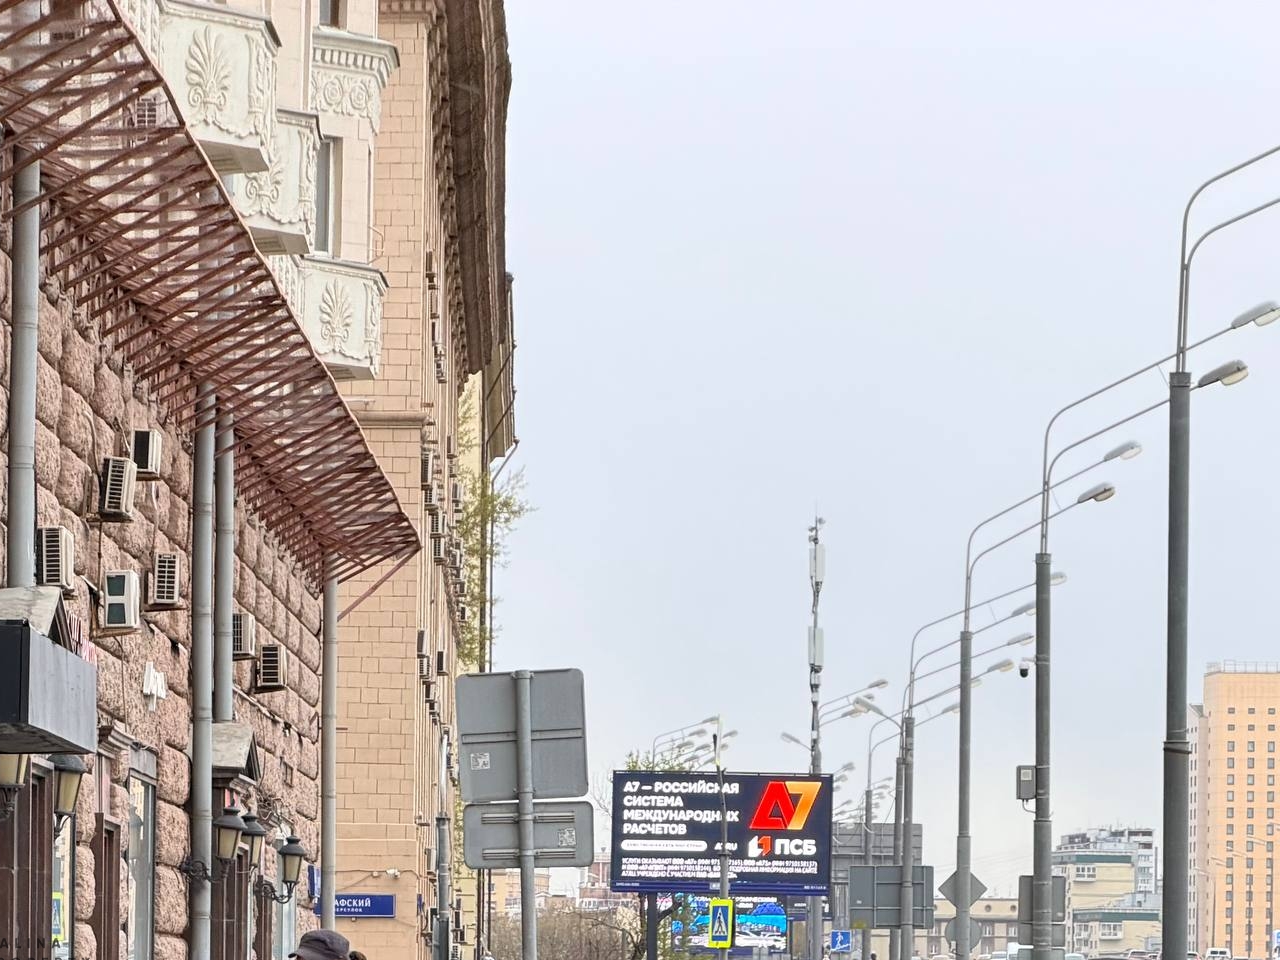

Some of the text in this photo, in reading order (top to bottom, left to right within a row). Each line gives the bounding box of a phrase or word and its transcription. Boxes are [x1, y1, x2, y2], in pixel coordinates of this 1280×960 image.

[623, 781, 640, 793] А7
[623, 795, 683, 807] СИСТЕМА
[749, 781, 822, 830] А7
[623, 823, 687, 835] РАСЧЕТОВ
[774, 838, 817, 855] ПСБ
[335, 897, 371, 908] АФСКИЙ
